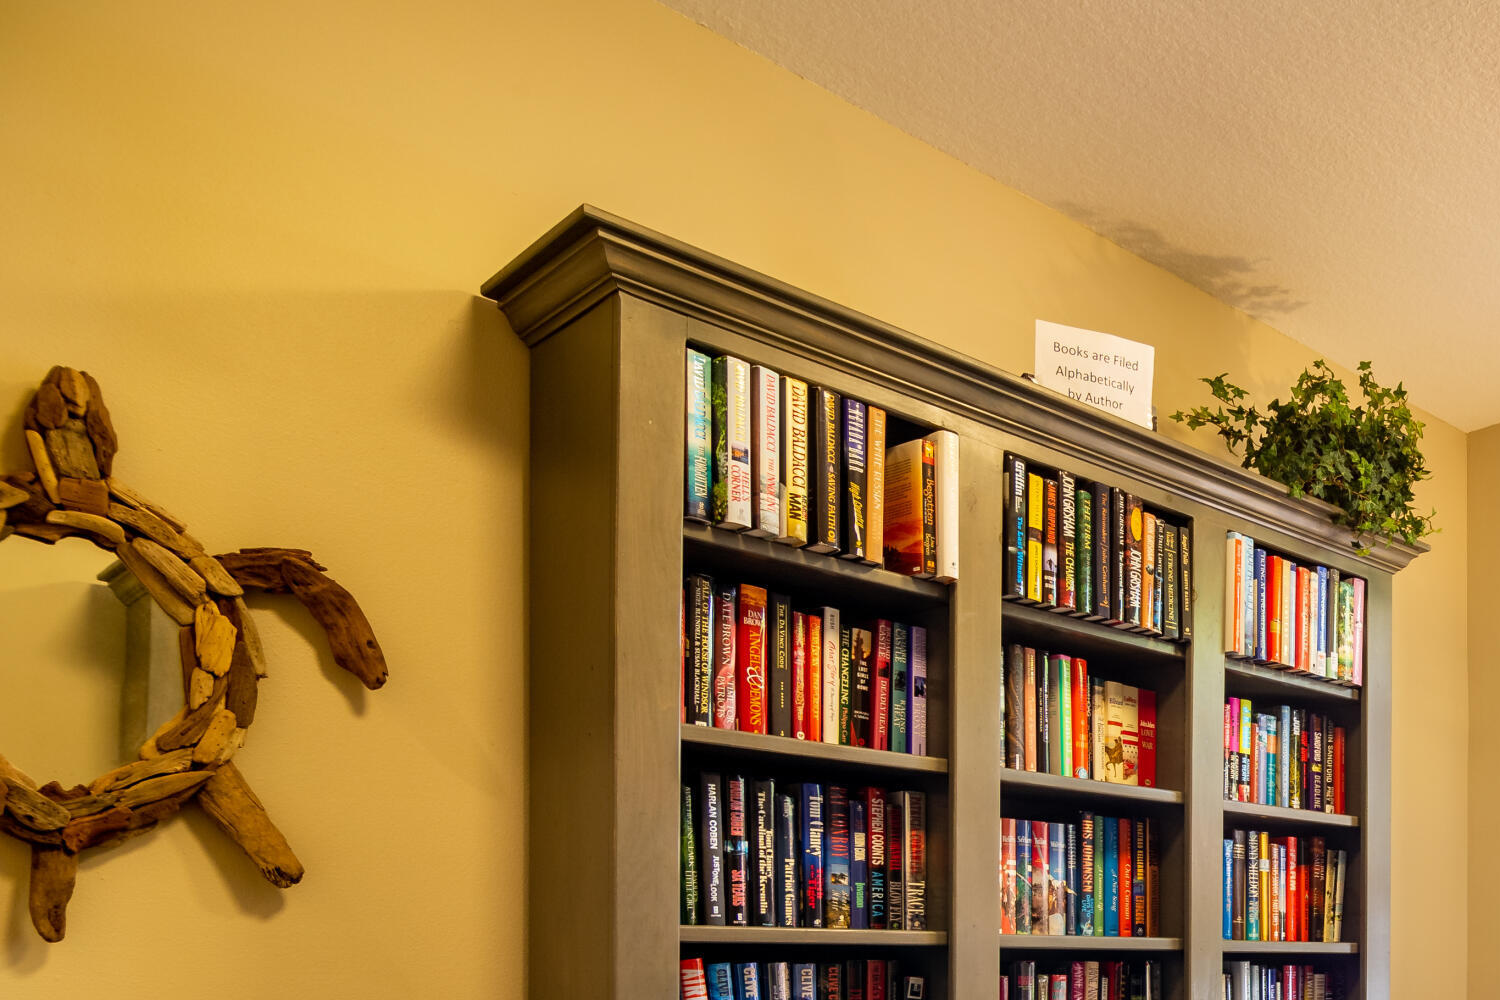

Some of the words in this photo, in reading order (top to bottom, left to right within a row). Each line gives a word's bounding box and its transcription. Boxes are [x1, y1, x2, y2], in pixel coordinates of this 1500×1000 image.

[1054, 342, 1088, 358] Books
[1092, 352, 1110, 362] are
[1114, 356, 1139, 371] Filed
[766, 374, 775, 406] DAVID
[1056, 366, 1134, 396] Alphabetically
[792, 385, 805, 424] DAVID
[827, 395, 835, 420] DAVID
[1068, 388, 1082, 401] by
[1085, 393, 1123, 410] Author
[766, 407, 775, 452] BALDACCI
[827, 422, 835, 464] BALDACCI
[792, 427, 805, 489] BALDACCI
[731, 465, 741, 502] CORNER
[741, 472, 750, 501] HELL'S
[1015, 461, 1025, 495] Griffin
[1062, 475, 1074, 498] JOHN
[789, 493, 801, 520] MAN
[1063, 499, 1074, 537] GRISHAM
[1066, 542, 1074, 557] THE
[1130, 548, 1141, 570] JOHN
[1066, 558, 1074, 591] CHAMBER
[1166, 553, 1174, 581] STRONG
[1130, 570, 1142, 607] GRISHAM
[702, 602, 709, 613] OF
[722, 592, 732, 620] DALE
[748, 610, 762, 619] DAN
[722, 623, 731, 665] BROWN
[842, 630, 850, 646] THE
[894, 628, 902, 662] CASTLE
[701, 662, 709, 673] OF
[841, 648, 850, 704] CHANGELING
[700, 675, 709, 713] WINDSOR
[717, 676, 726, 718] PATRIOTS
[879, 680, 887, 710] DEADLY
[879, 712, 887, 734] HEAT
[708, 784, 717, 818] HARLAN
[809, 795, 822, 818] Tom
[871, 798, 884, 832] STEPHEN
[709, 820, 718, 849] COBEN
[806, 821, 823, 857] Clancy
[1082, 820, 1093, 840] IRIS
[872, 834, 884, 865] COONTS
[732, 870, 746, 882] SIX
[784, 858, 794, 892] Patriot
[1082, 842, 1093, 892] JOHANSEN
[733, 884, 746, 906] YEARS
[872, 872, 884, 917] AMERICA
[907, 881, 925, 916] TRACE
[785, 894, 794, 926] Games
[717, 969, 728, 996] CLIVE
[743, 968, 753, 998] CLIVE
[801, 968, 812, 998] CLIVE
[828, 967, 838, 993] CLIVE
